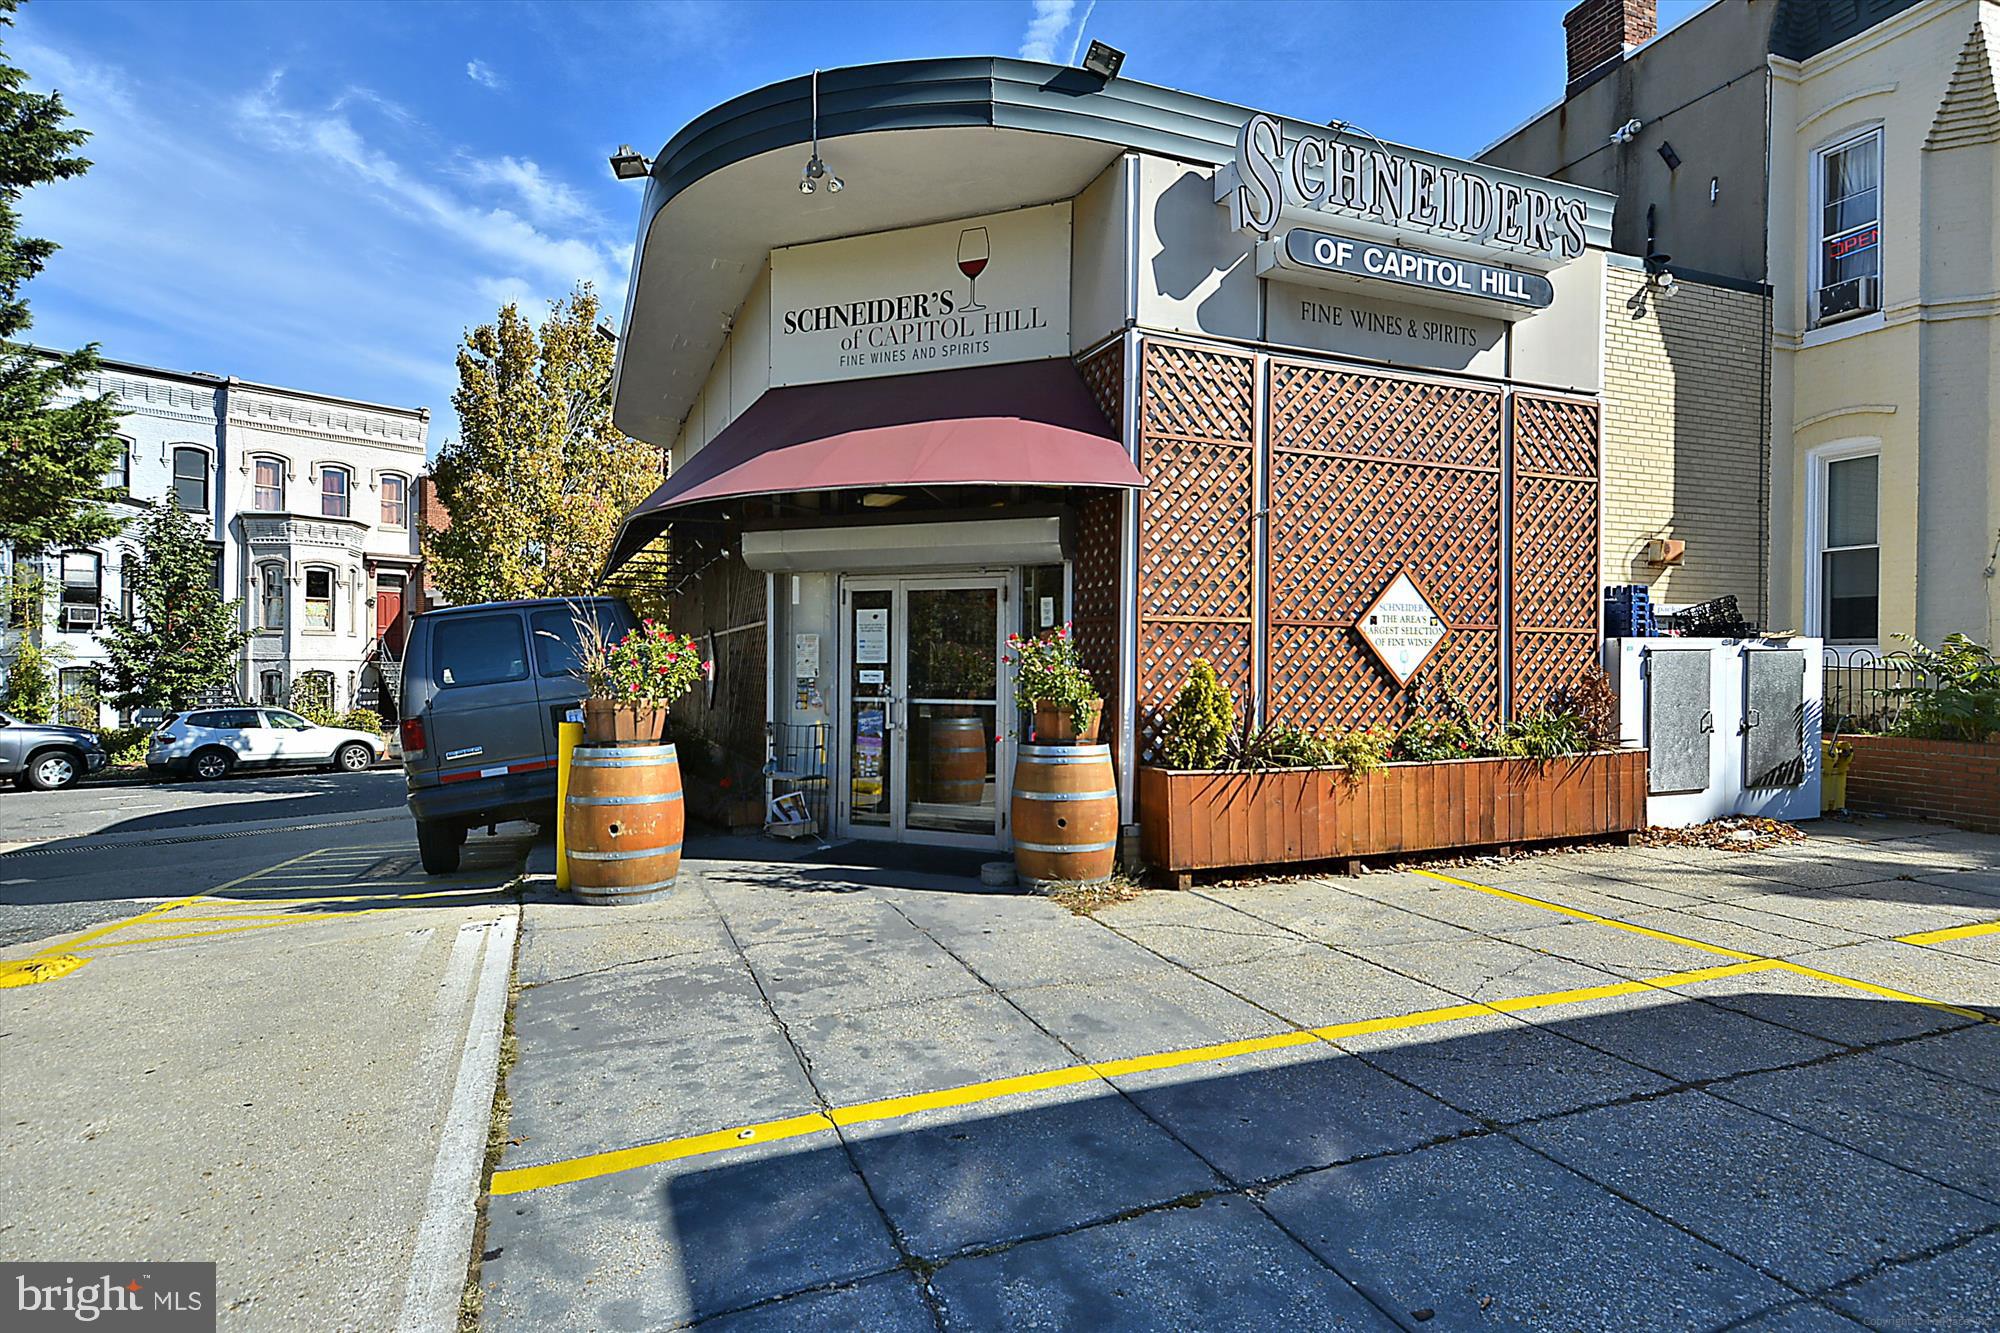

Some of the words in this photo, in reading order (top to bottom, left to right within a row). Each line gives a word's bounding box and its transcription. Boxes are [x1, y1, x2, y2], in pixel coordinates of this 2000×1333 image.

[1236, 113, 1588, 259] SCHNEIDER'S
[1314, 238, 1354, 270] OF
[1363, 247, 1471, 290] CAPITOL
[1481, 271, 1531, 300] HILL
[783, 289, 954, 335] SCHNEIDER'S
[840, 328, 863, 351] of
[868, 316, 974, 348] CAPITOL
[983, 306, 1048, 334] HILL
[1301, 301, 1343, 327] FINE
[1350, 311, 1402, 337] WINES
[1407, 321, 1418, 338] &
[1422, 322, 1477, 347] SPIRITS
[840, 354, 865, 367] FINE
[870, 349, 906, 364] WINES
[912, 346, 936, 360] AND
[942, 340, 990, 356] SPIRITS
[1382, 614, 1398, 623] THE
[1400, 614, 1427, 624] AREA'S
[1375, 638, 1386, 646] OF
[1388, 638, 1405, 646] FINE
[1407, 638, 1432, 647] WINES
